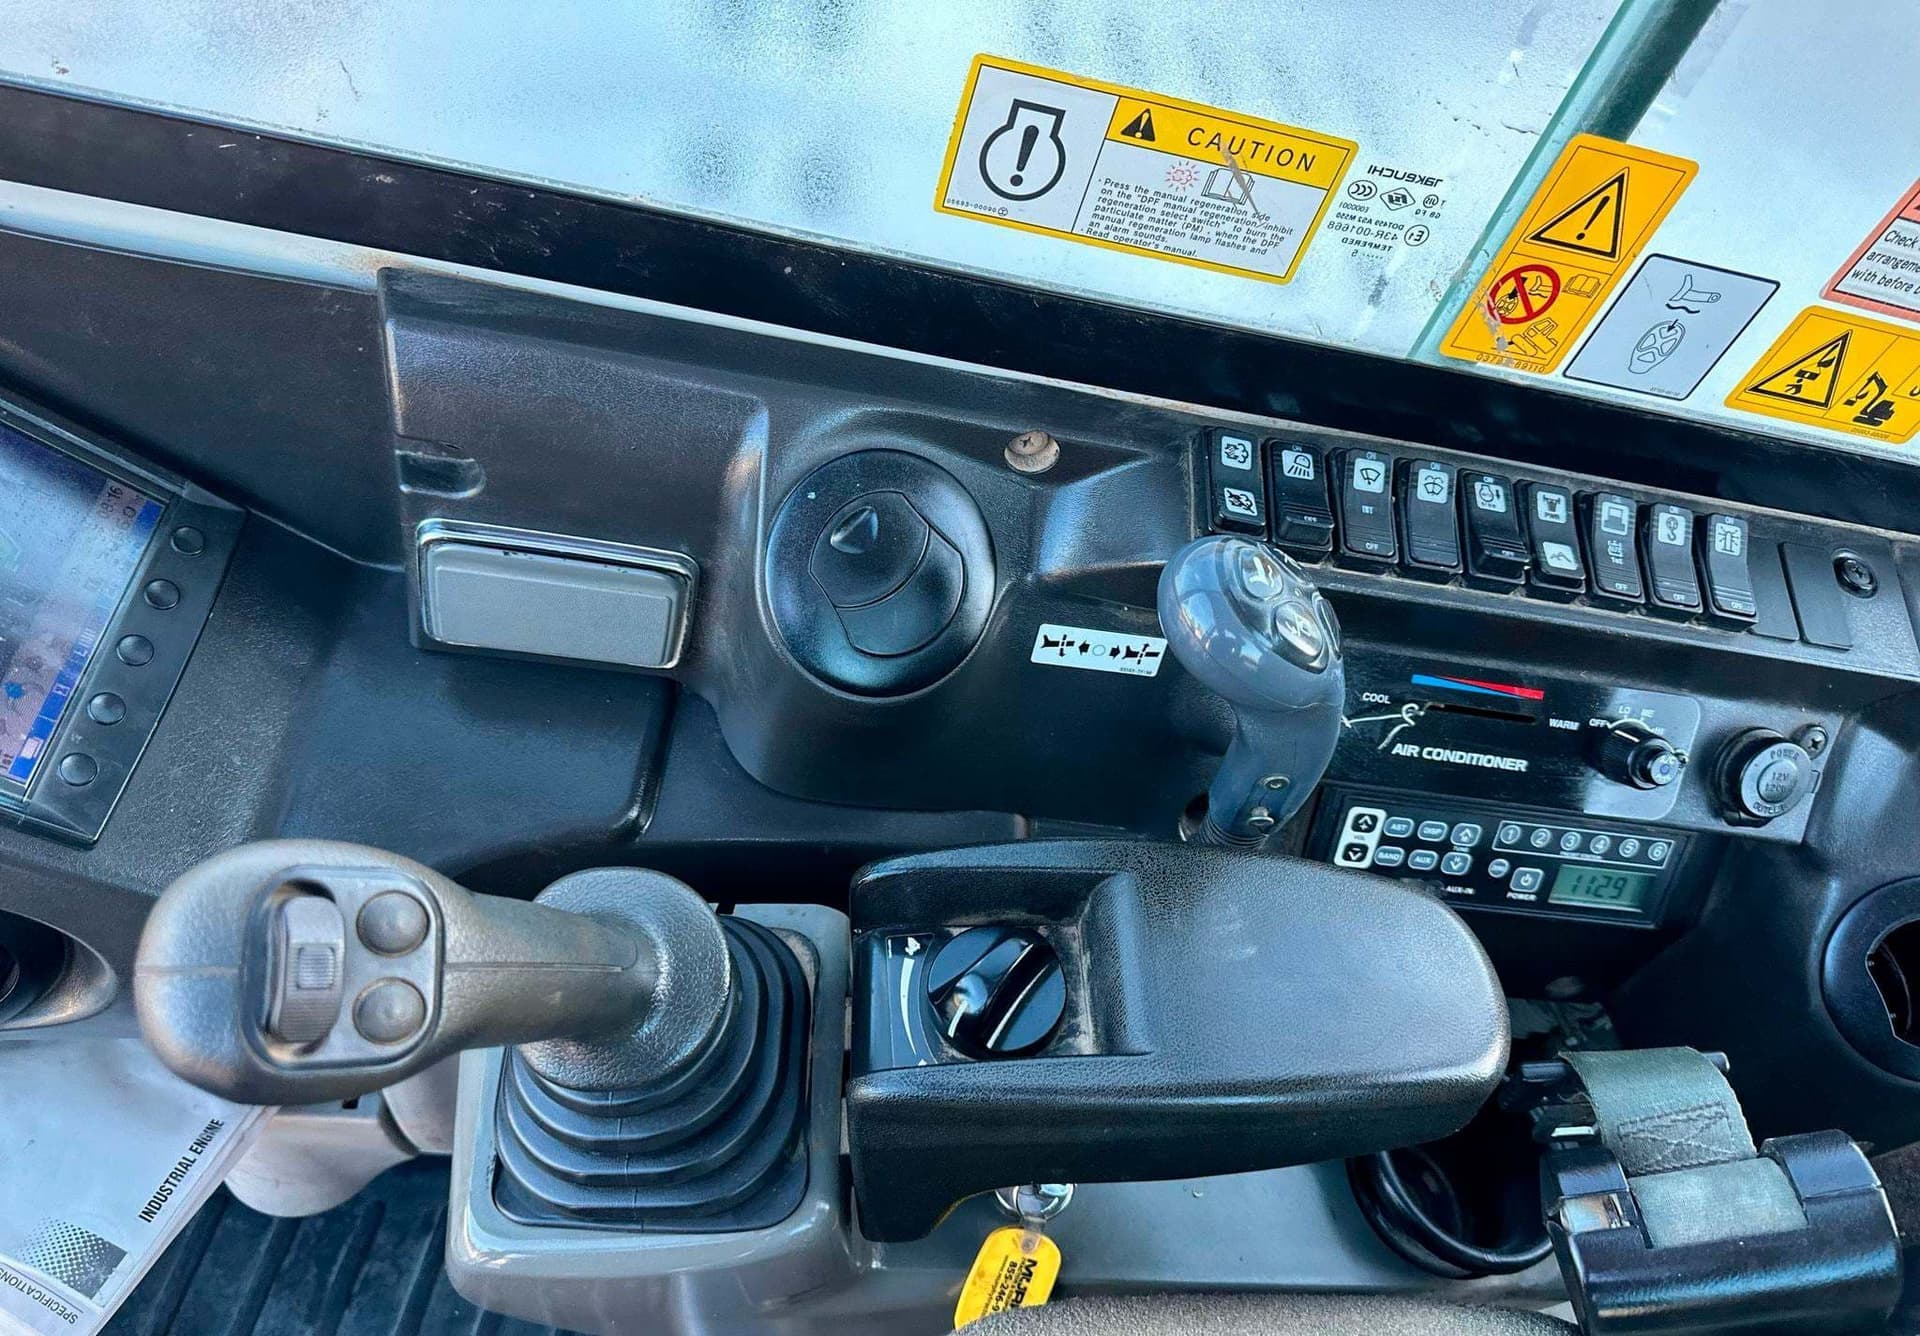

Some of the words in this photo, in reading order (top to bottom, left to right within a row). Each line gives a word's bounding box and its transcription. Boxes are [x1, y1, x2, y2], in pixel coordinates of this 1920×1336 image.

[1188, 127, 1316, 172] CAUTION
[1100, 188, 1112, 196] on
[1117, 190, 1132, 200] the
[1163, 202, 1198, 214] manual
[1104, 178, 1130, 190] Press
[1134, 186, 1150, 194] the
[1153, 190, 1188, 203] manual
[1190, 199, 1248, 217] regeneration
[1251, 212, 1270, 222] side
[1088, 220, 1100, 229] an
[1104, 224, 1130, 235] alarm
[1134, 229, 1168, 243] sounds.
[1094, 204, 1144, 220] particulate
[1148, 215, 1178, 228] matter
[1216, 230, 1239, 241] when
[1242, 236, 1258, 245] the
[1260, 239, 1280, 250] DPF
[1098, 196, 1156, 214] regeneration
[1160, 209, 1188, 222] select
[1233, 225, 1242, 233] to
[1246, 228, 1267, 239] burn
[1270, 232, 1284, 242] the
[1086, 228, 1110, 239] Read
[1113, 234, 1160, 250] operator's
[1163, 245, 1198, 258] manual.
[1092, 212, 1126, 226] manual
[1128, 220, 1186, 238] regeneration
[1190, 232, 1212, 244] lamp
[1215, 238, 1246, 252] flashes
[1250, 247, 1268, 256] and
[1884, 230, 1919, 249] Check
[1852, 269, 1878, 283] with
[1876, 274, 1914, 292] before
[1362, 691, 1392, 704] COOL
[1548, 718, 1580, 732] WARM
[1391, 743, 1419, 758] AIR
[1422, 746, 1529, 772] CONDITIONER
[138, 1156, 197, 1224] INDUSTRIAL
[188, 1118, 225, 1156] ENGINE
